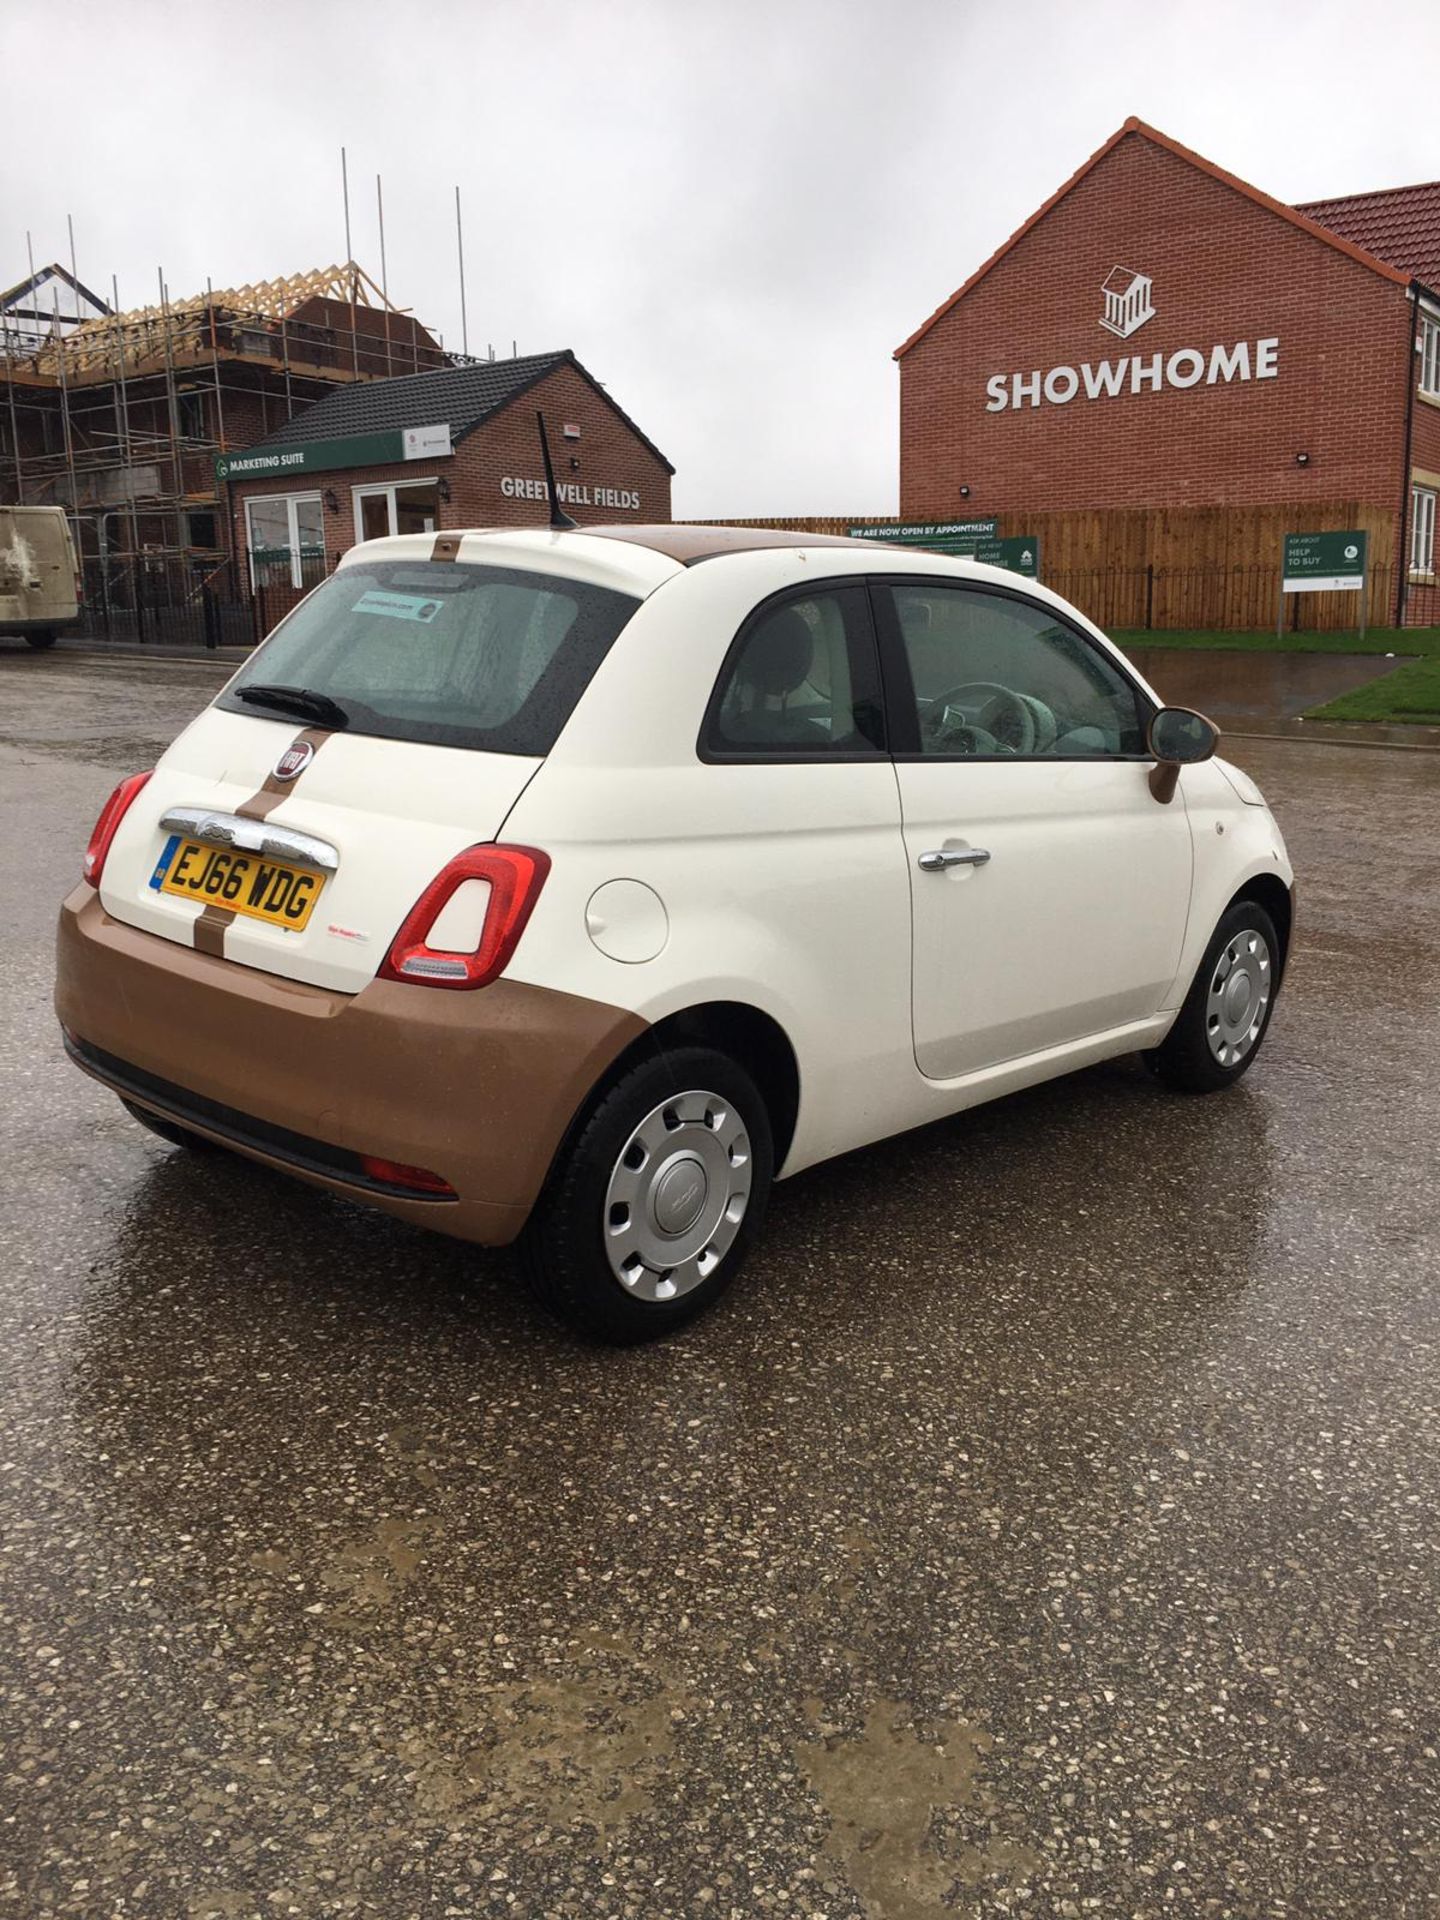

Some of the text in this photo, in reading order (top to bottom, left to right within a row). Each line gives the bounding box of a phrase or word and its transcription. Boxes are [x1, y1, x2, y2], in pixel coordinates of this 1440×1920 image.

[985, 337, 1279, 413] SHOWHOME
[229, 452, 305, 472] MARKETING SUITE
[500, 476, 640, 510] GREETWELL FIELDS
[850, 523, 994, 537] WE ARE NOW OPEN BY APPOINTMENT
[978, 552, 1000, 560] HOME
[1288, 548, 1311, 557] HELP
[1288, 556, 1321, 566] TO BUY
[171, 845, 315, 919] EJ66 WDG
